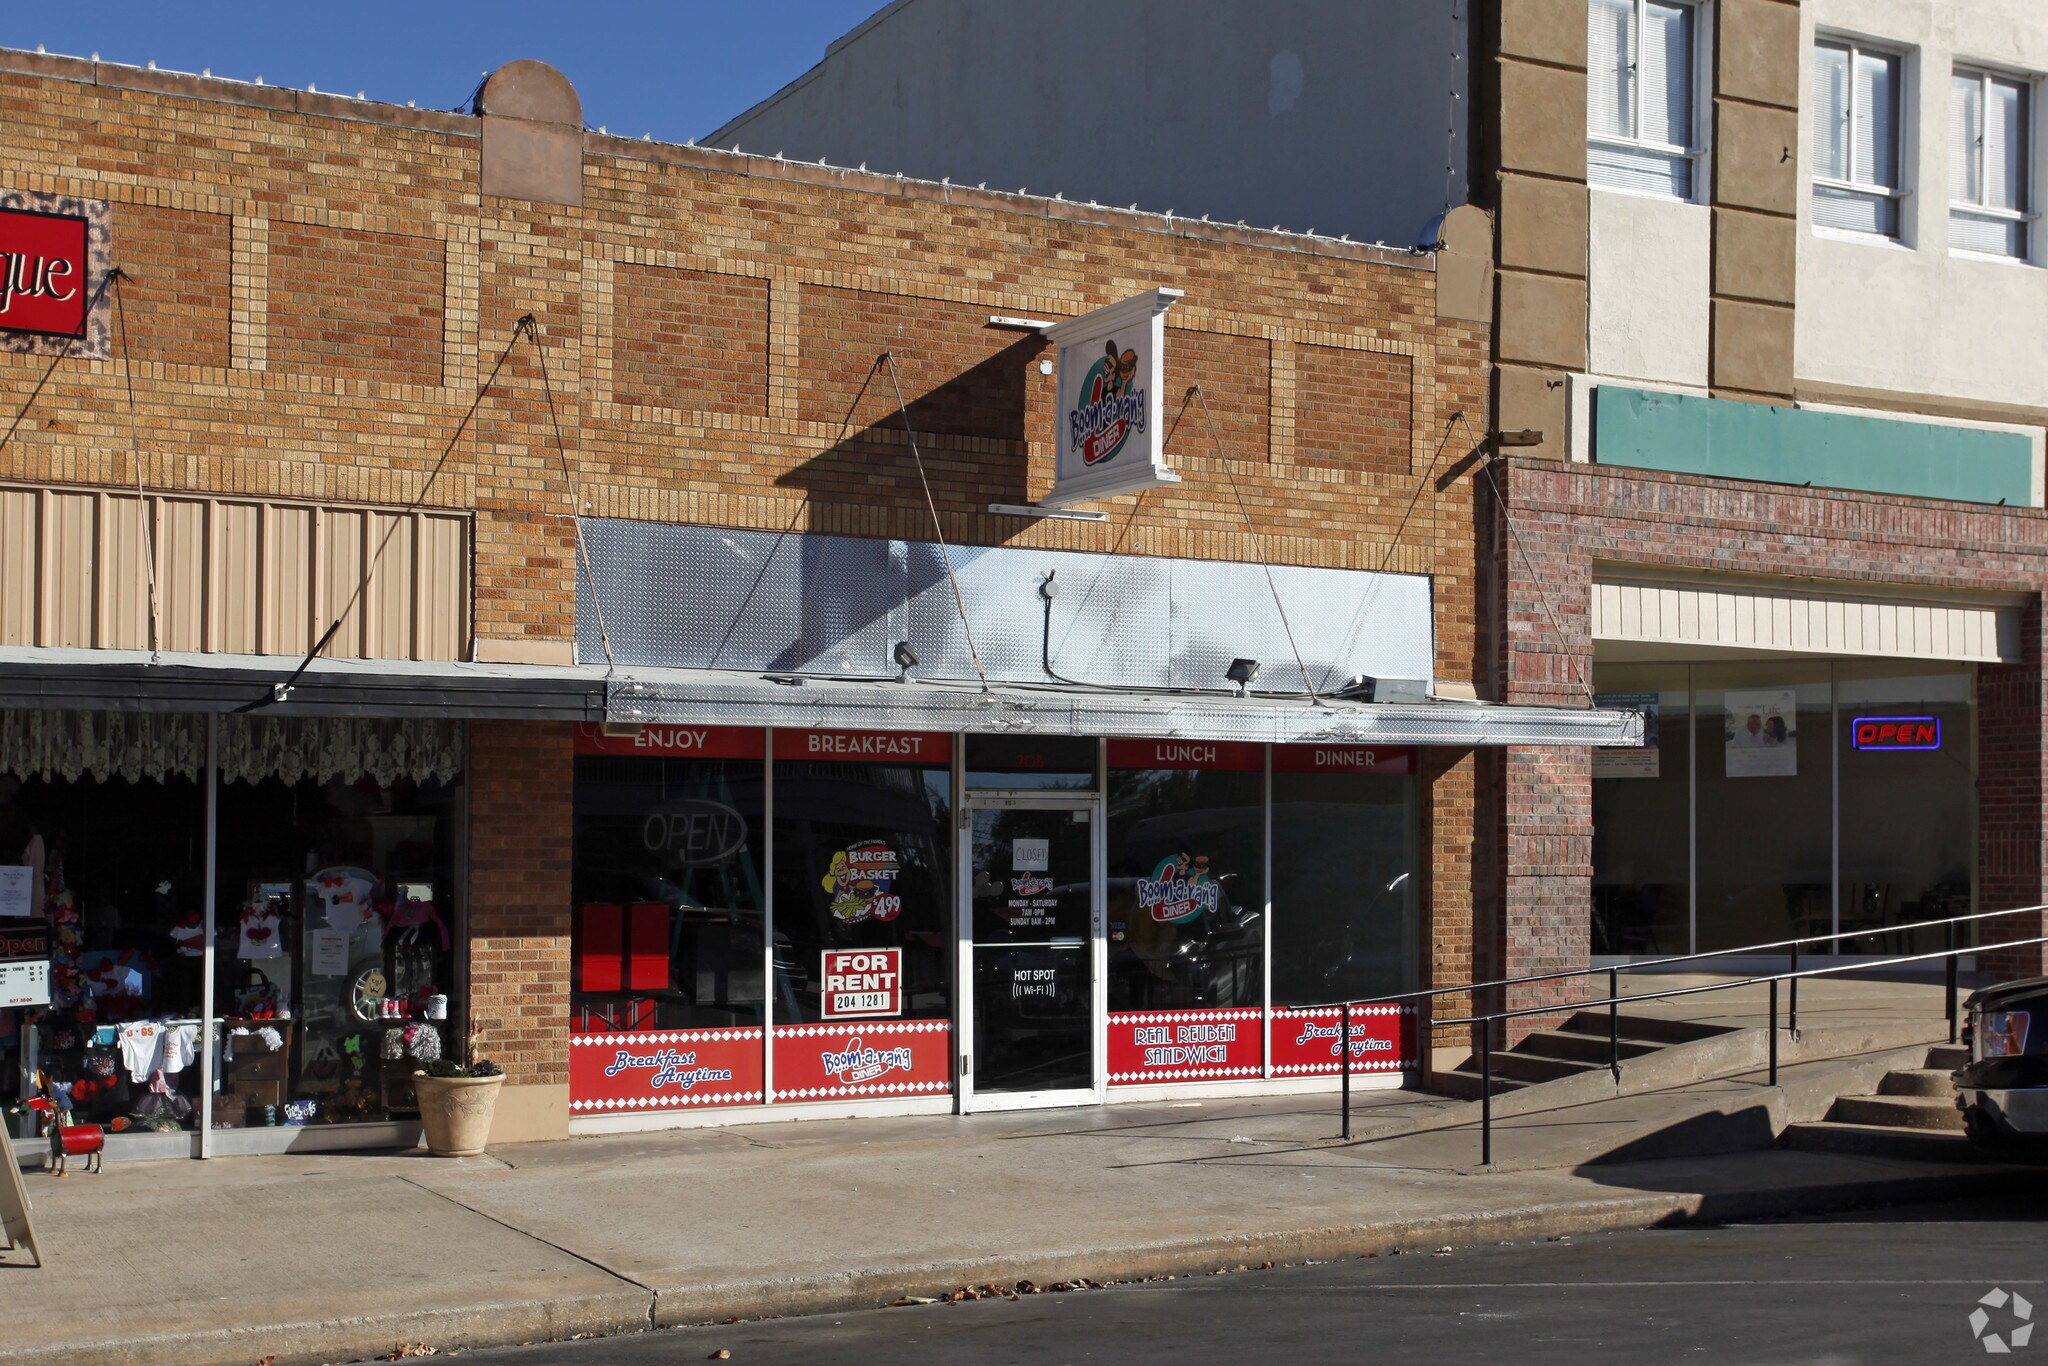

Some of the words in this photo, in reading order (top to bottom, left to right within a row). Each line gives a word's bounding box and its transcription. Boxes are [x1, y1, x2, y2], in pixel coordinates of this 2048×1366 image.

[1093, 424, 1120, 457] DINER
[635, 730, 707, 749] ENJOY
[1857, 724, 1935, 743] OPEN
[808, 735, 923, 754] BREAKFAST
[1156, 745, 1217, 763] LUNCH
[1315, 751, 1376, 766] DINNER
[644, 813, 730, 851] OPEN
[849, 851, 898, 864] BURGER
[850, 868, 900, 880] BASKET
[1008, 899, 1029, 907] MONDAY
[1033, 899, 1058, 907] SATURDAY
[1162, 901, 1191, 918] DINER
[1010, 918, 1029, 926] SUNDAY
[836, 954, 888, 972] FOR
[828, 973, 896, 991] RENT
[1014, 970, 1031, 981] HOT
[1033, 969, 1055, 980] SPOT
[837, 996, 855, 1008] 204
[862, 994, 884, 1006] 1281
[1134, 1026, 1173, 1045] REAL
[1177, 1023, 1236, 1043] REUBEN
[604, 1049, 697, 1076] Breakfast
[1144, 1044, 1227, 1066] SANDWICH
[651, 1066, 732, 1089] Anytime
[851, 1064, 882, 1080] DINER
